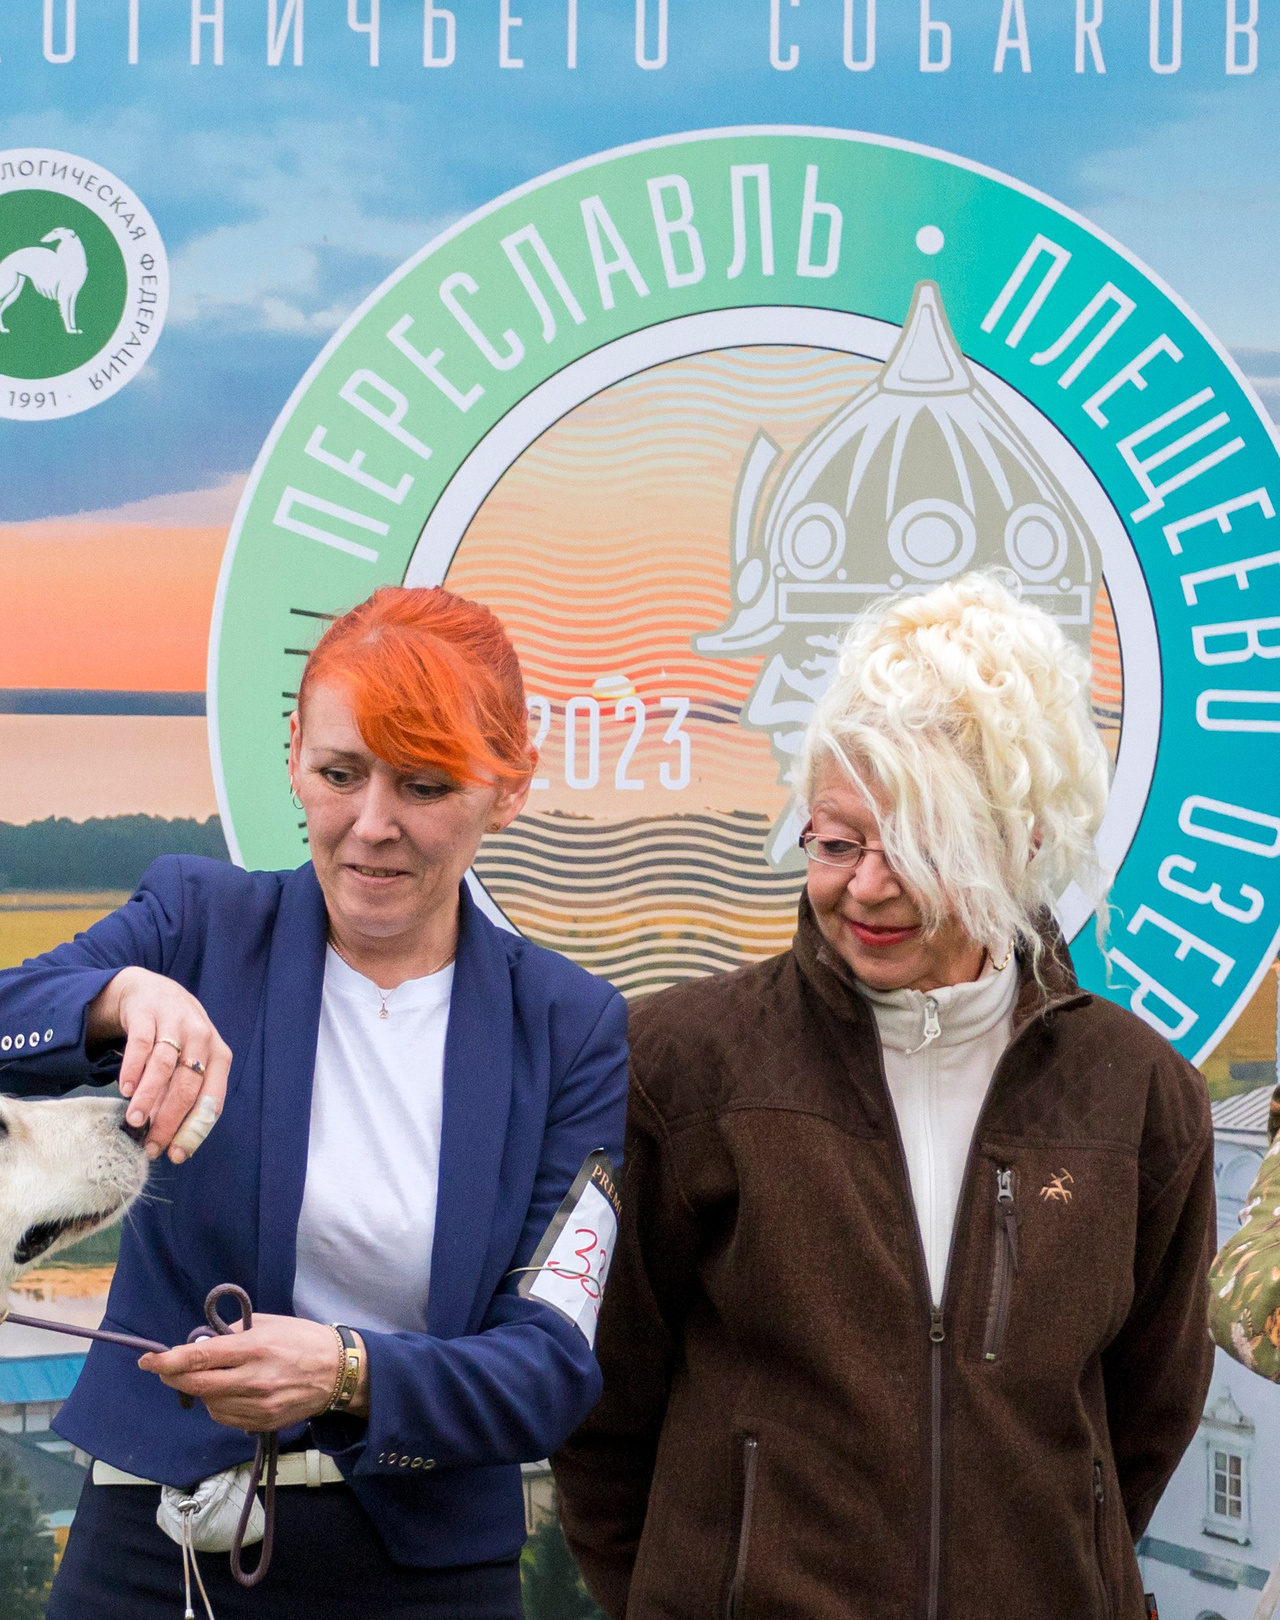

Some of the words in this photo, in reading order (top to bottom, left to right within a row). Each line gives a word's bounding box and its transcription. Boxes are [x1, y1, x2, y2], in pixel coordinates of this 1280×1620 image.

[8, 391, 58, 409] 1991
[87, 253, 158, 391] ФЕДЕРАЦИЯ
[272, 163, 843, 563] ПЕРЕСЛАВЛЬ
[980, 232, 1280, 733] ПЛЕЩЕВО
[526, 695, 691, 791] 2023
[1107, 794, 1280, 1041] ОЗЕР
